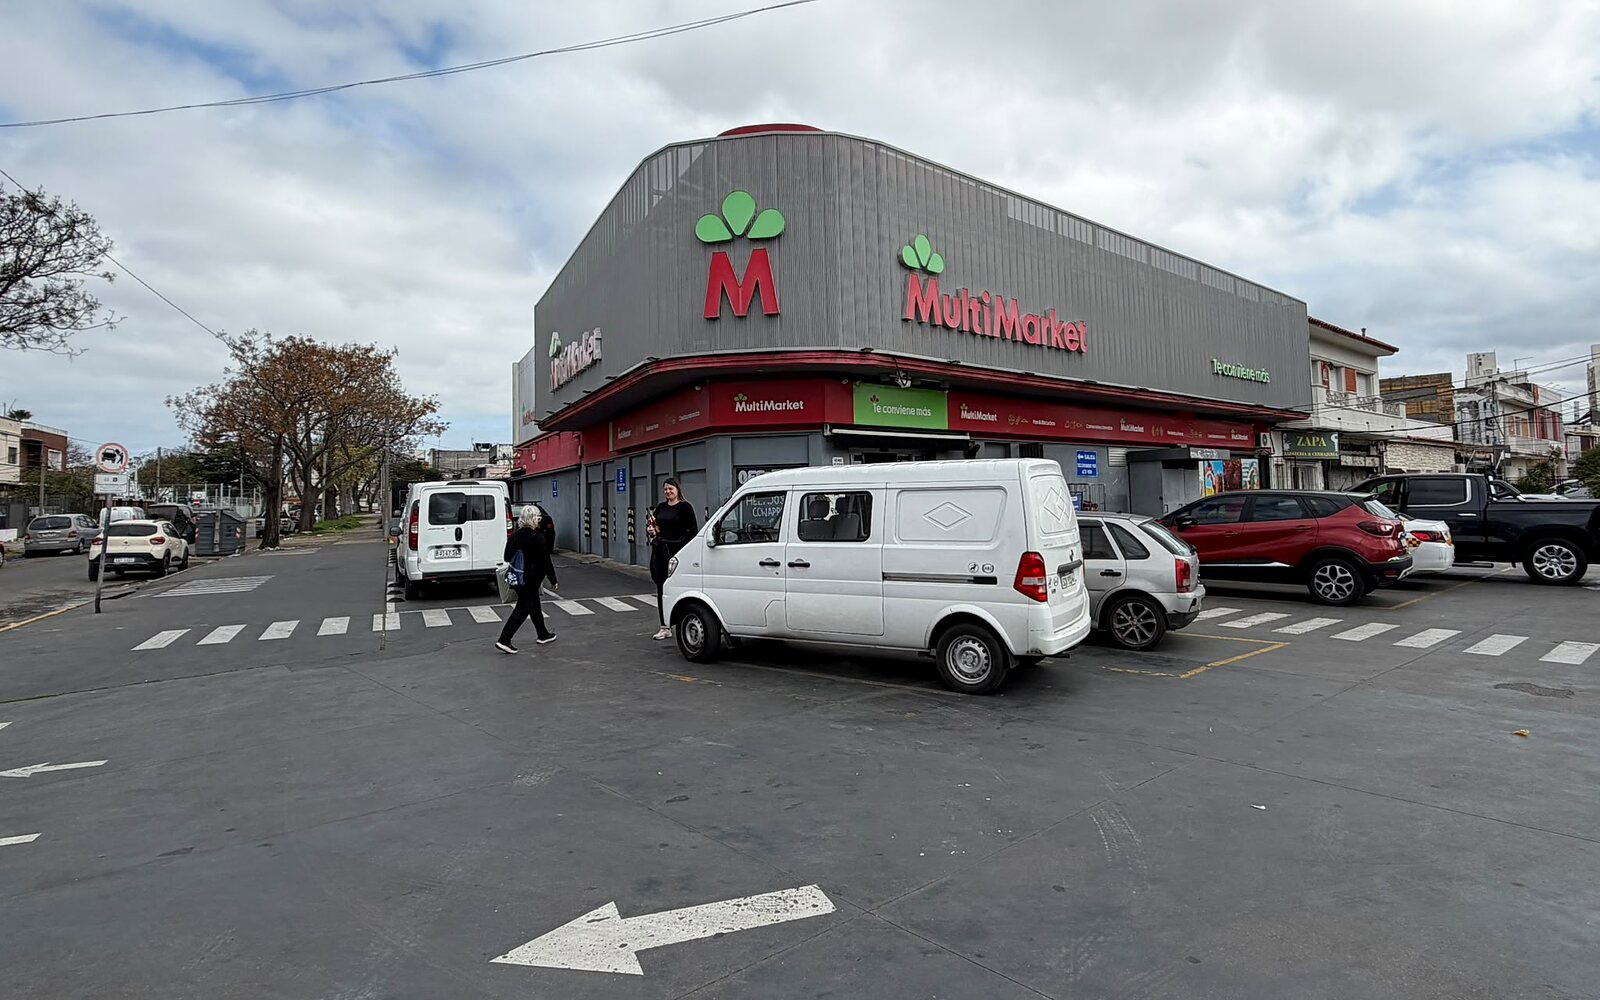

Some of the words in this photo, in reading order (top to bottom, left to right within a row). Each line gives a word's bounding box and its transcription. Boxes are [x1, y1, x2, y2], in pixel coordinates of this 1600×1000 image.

[704, 248, 780, 319] M
[904, 272, 1088, 354] MultiMarket
[735, 400, 804, 412] MultiMarket
[873, 403, 882, 413] Te
[883, 404, 916, 416] conviene
[916, 406, 932, 417] más
[961, 410, 997, 421] MultiMarket
[1296, 436, 1327, 447] ZAPA
